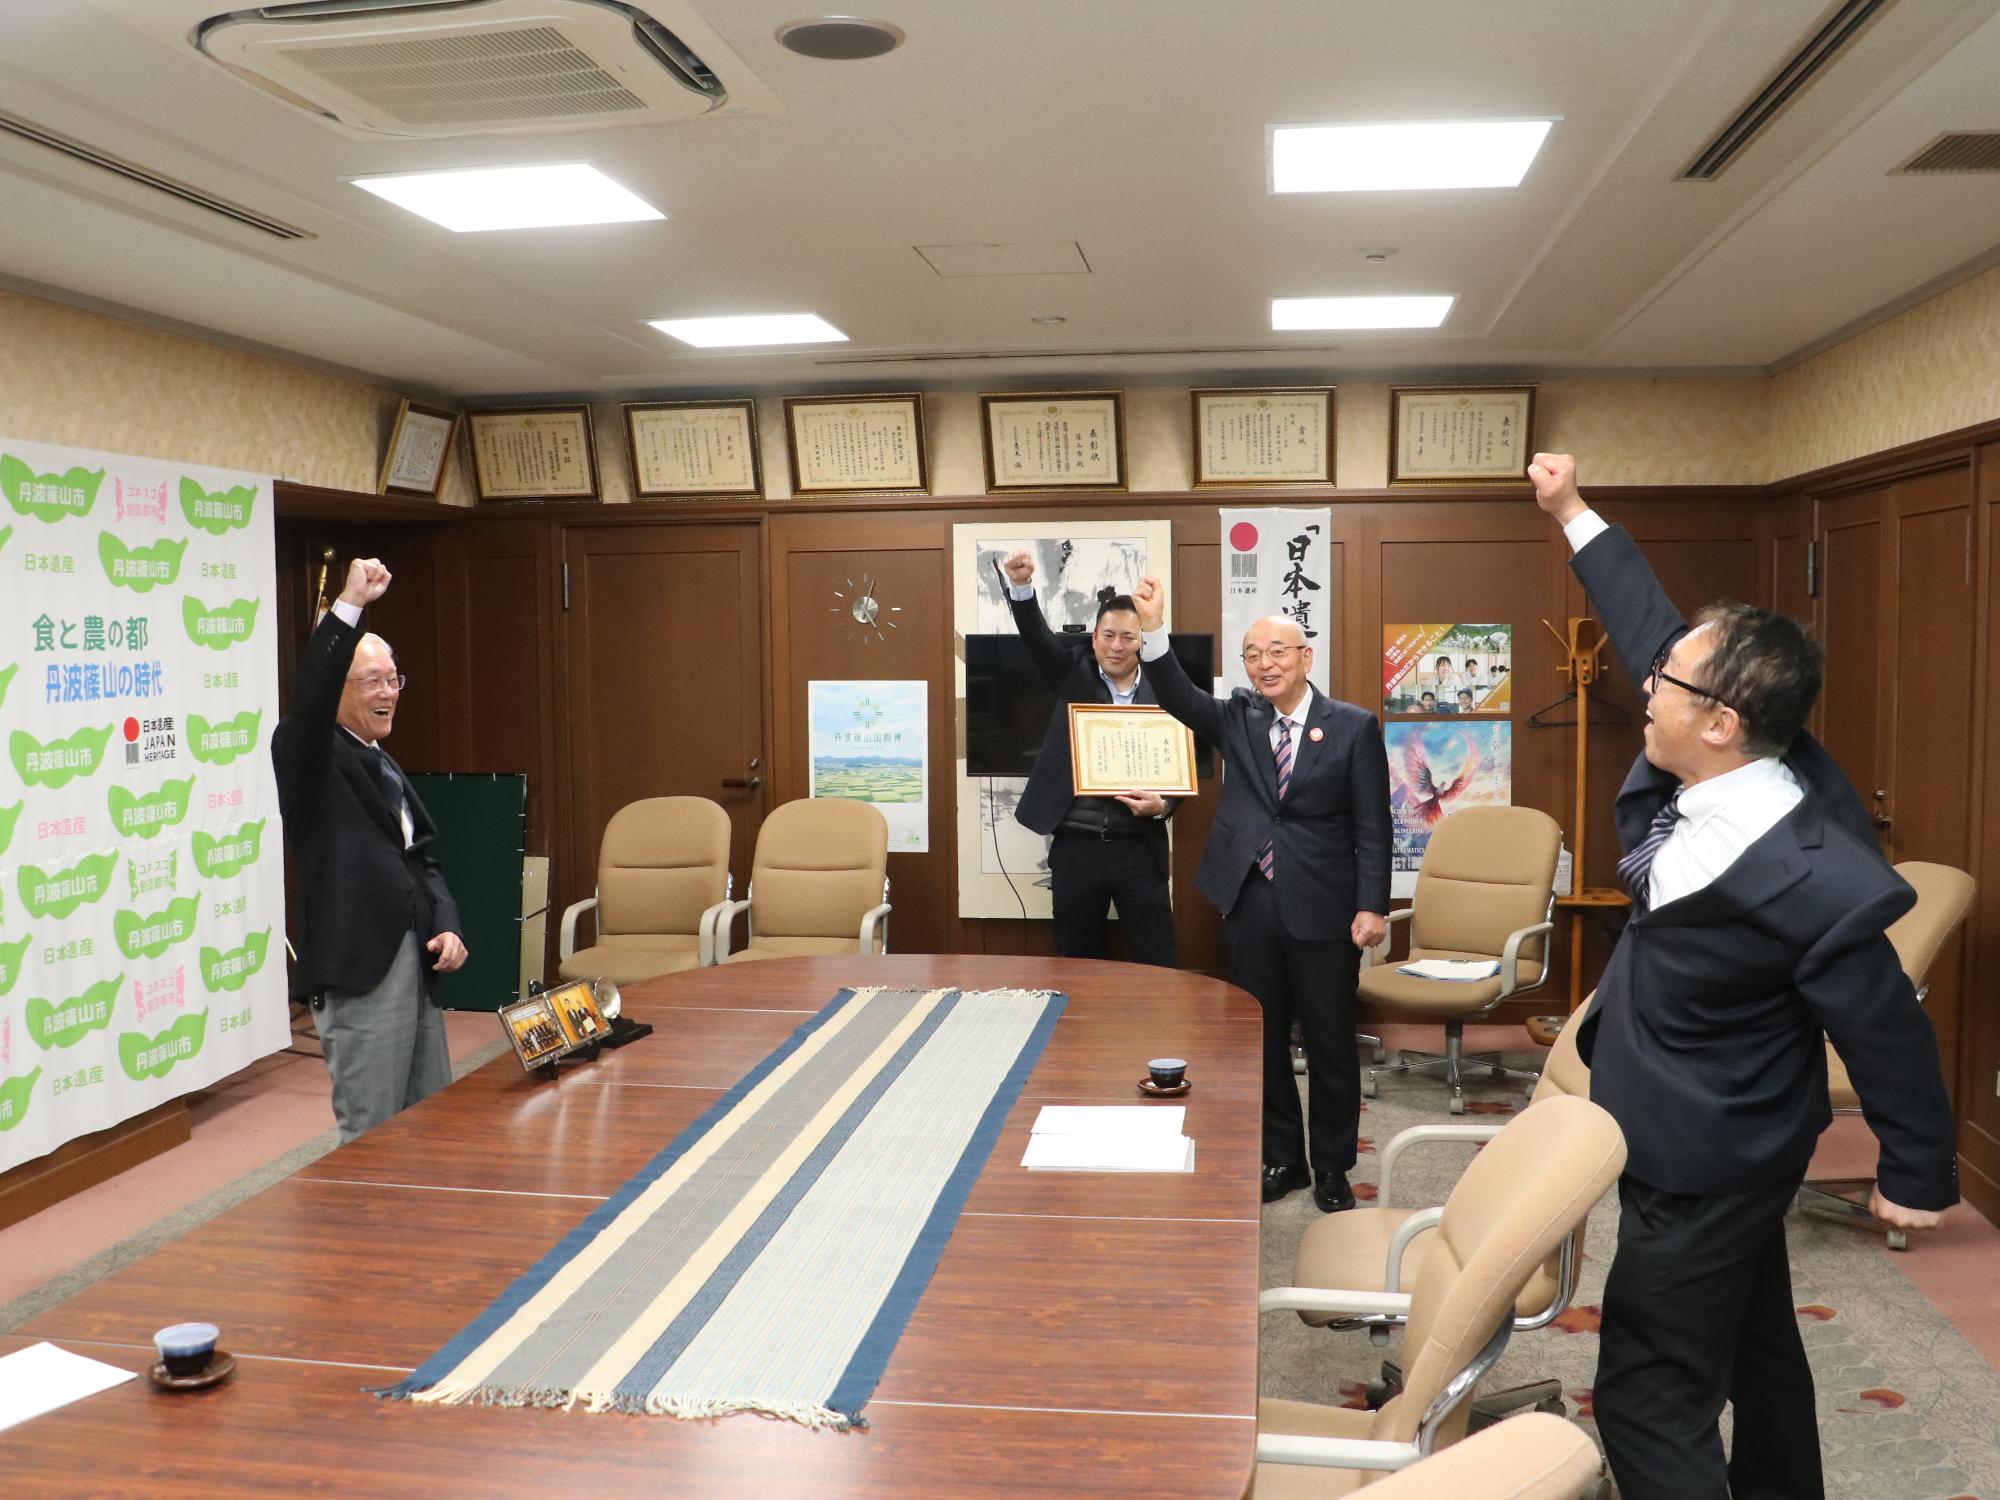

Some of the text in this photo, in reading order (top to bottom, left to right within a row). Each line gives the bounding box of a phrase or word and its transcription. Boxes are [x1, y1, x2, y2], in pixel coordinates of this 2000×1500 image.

[1089, 428, 1100, 461] 表彰状
[19, 482, 84, 507] 丹波篠山市
[194, 500, 242, 521] 丹波篠山市
[25, 553, 75, 574] 日本遺産
[113, 559, 170, 578] 丹波篠山市
[202, 562, 236, 579] 日本遺産
[32, 613, 149, 652] 食と農の都
[197, 617, 245, 636] 丹波篠山市
[46, 660, 163, 703] 丹波篠山の時代
[204, 672, 240, 689] 日本遺産
[143, 717, 174, 733] 日本遺産
[144, 734, 176, 750] JAPAN
[201, 729, 248, 751] 丹波篠山市
[26, 748, 92, 772] 丹波篠山市
[144, 749, 176, 762] HERITAGE
[208, 790, 243, 809] 日本遺産
[123, 801, 177, 827] 丹波篠山市
[38, 816, 87, 840] 日本遺産
[207, 840, 252, 867] 丹波篠山市
[34, 875, 98, 906] 丹波篠山市
[214, 896, 247, 918] 日本遺産
[128, 919, 182, 949] 丹波篠山市
[44, 938, 95, 966] 日本遺産
[211, 950, 256, 981] 丹波篠山市
[44, 1001, 108, 1037] 丹波篠山市
[136, 1036, 192, 1072] 丹波篠山市
[53, 1066, 104, 1096] 日本遺産
